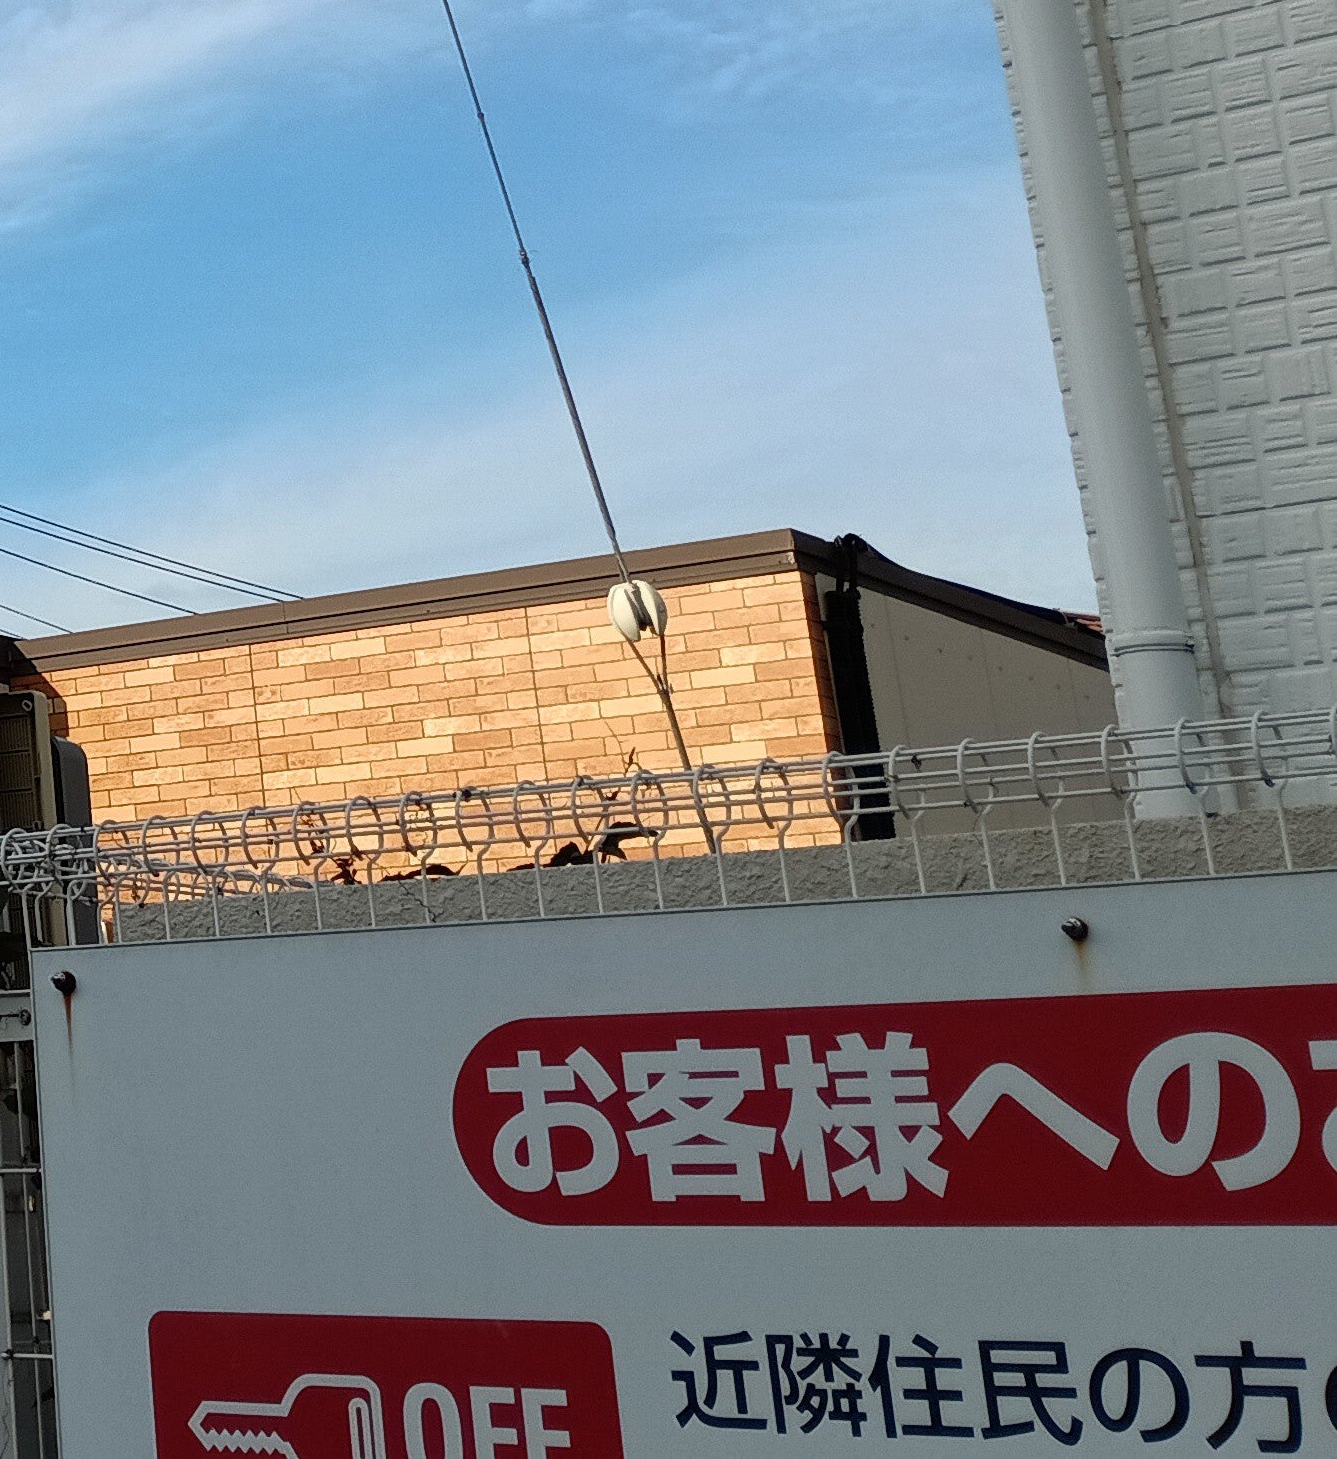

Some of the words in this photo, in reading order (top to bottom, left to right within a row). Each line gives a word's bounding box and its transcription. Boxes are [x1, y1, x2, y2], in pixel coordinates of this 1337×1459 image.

[486, 1031, 1337, 1202] お客様への
[403, 1382, 571, 1459] OFF
[669, 1330, 1337, 1454] 近隣住民の方
